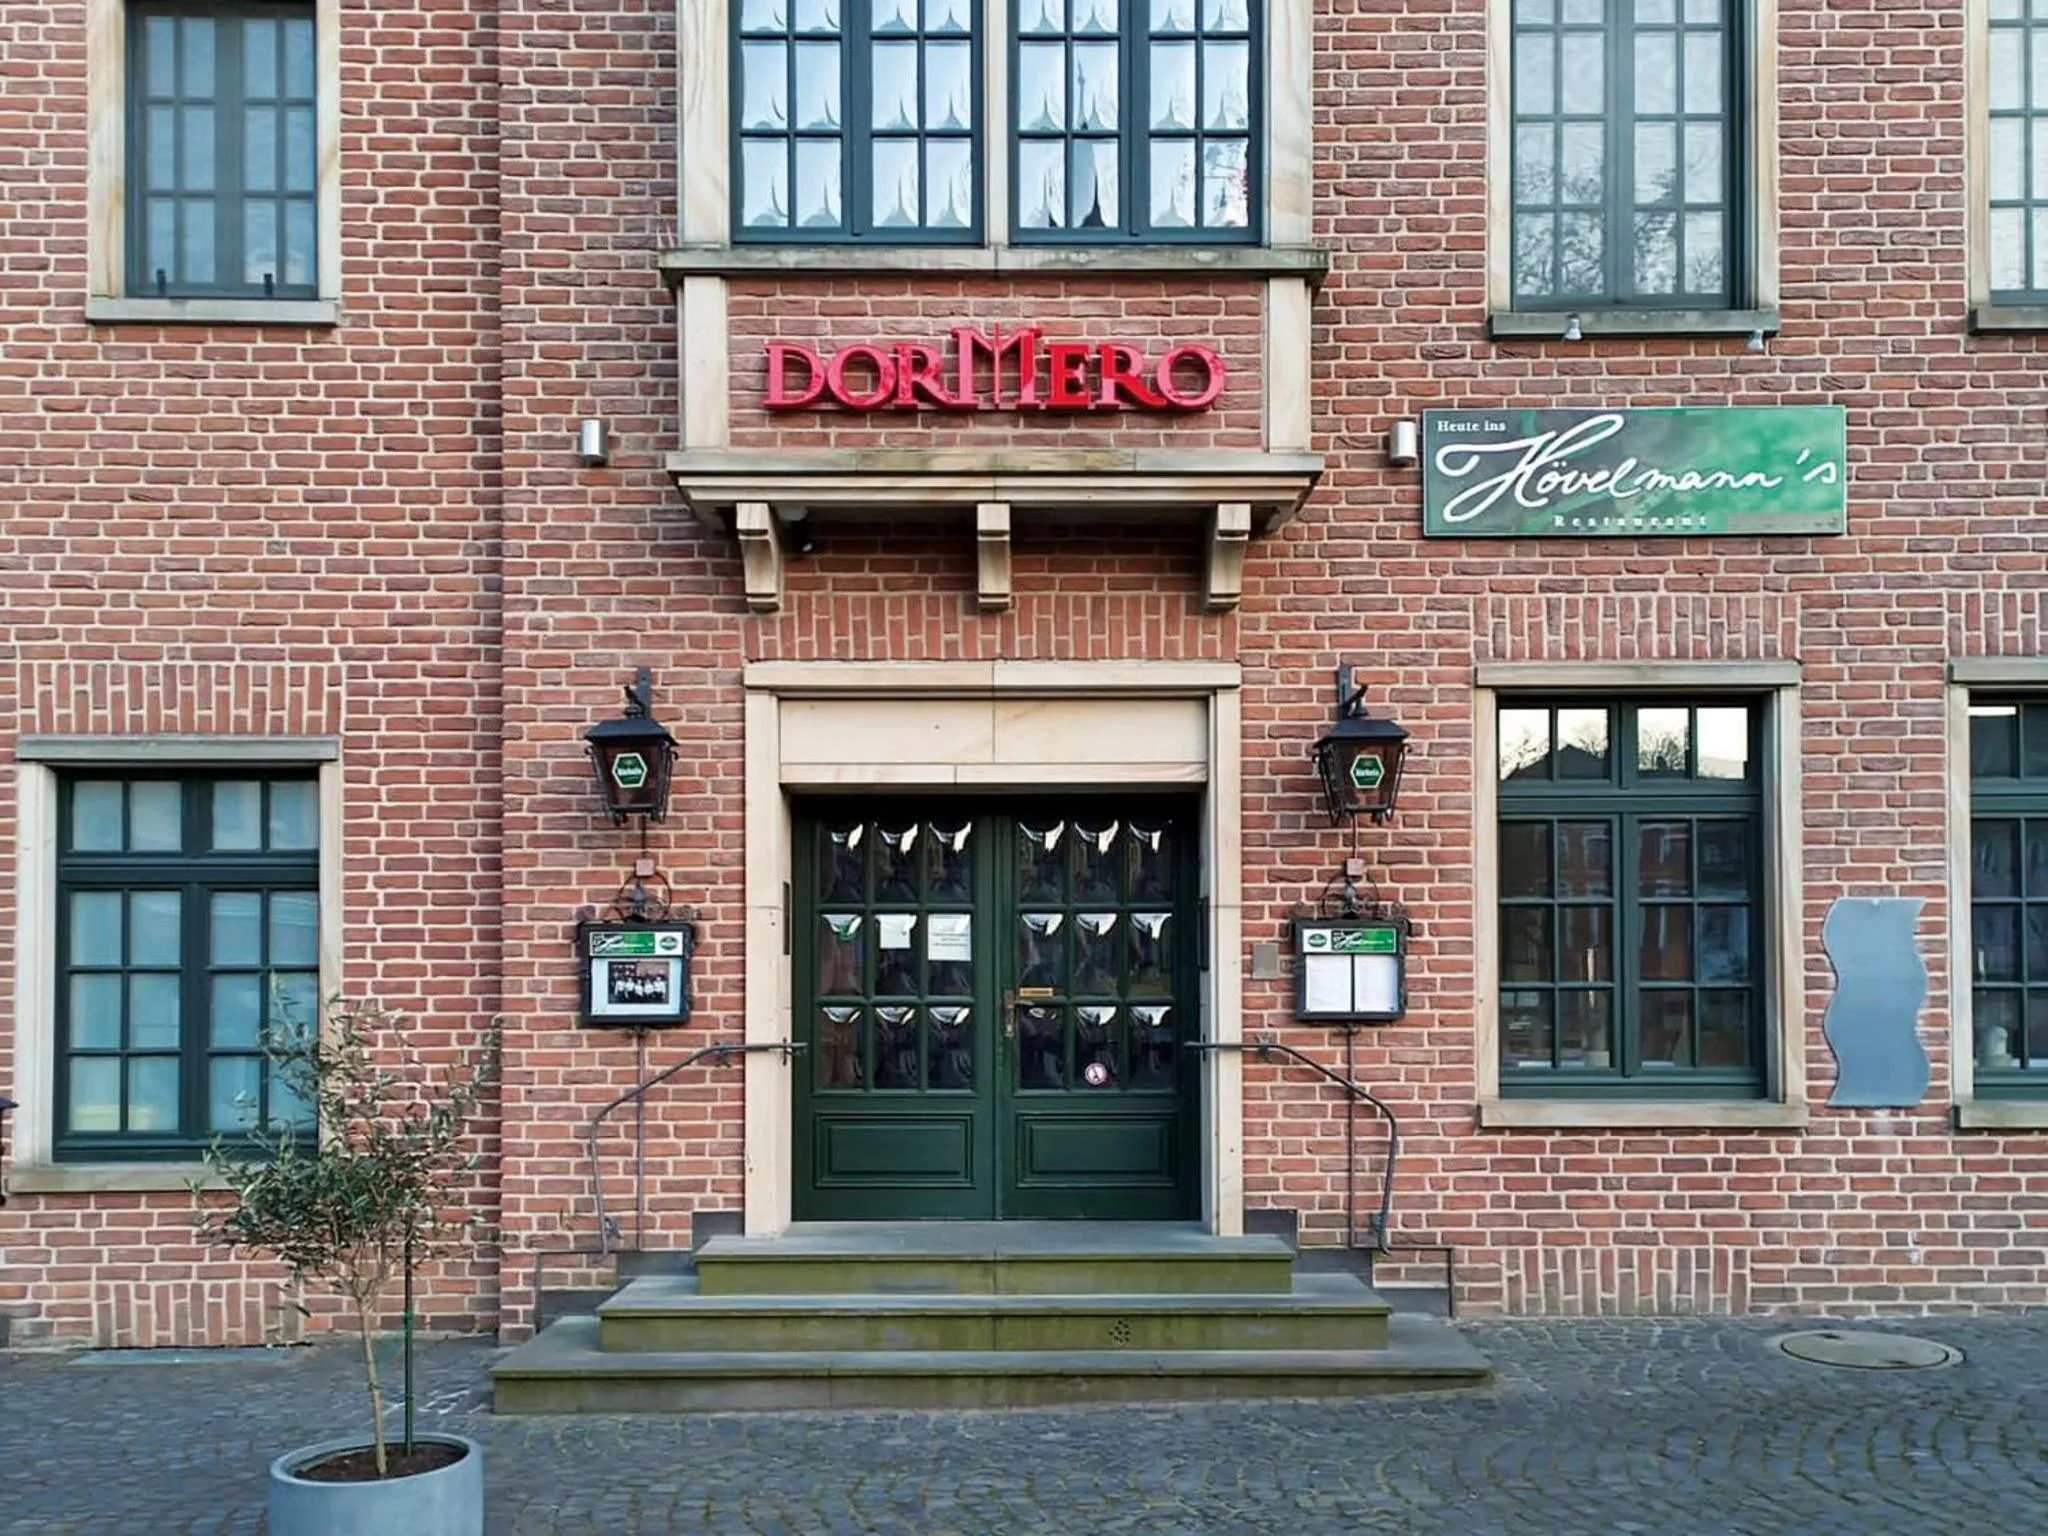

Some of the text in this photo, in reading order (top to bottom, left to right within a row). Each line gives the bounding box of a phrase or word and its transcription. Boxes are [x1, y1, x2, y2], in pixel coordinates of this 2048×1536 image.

[763, 322, 1226, 410] DORMERO
[1437, 419, 1507, 433] Heute ins
[1553, 514, 1708, 527] Restaurant
